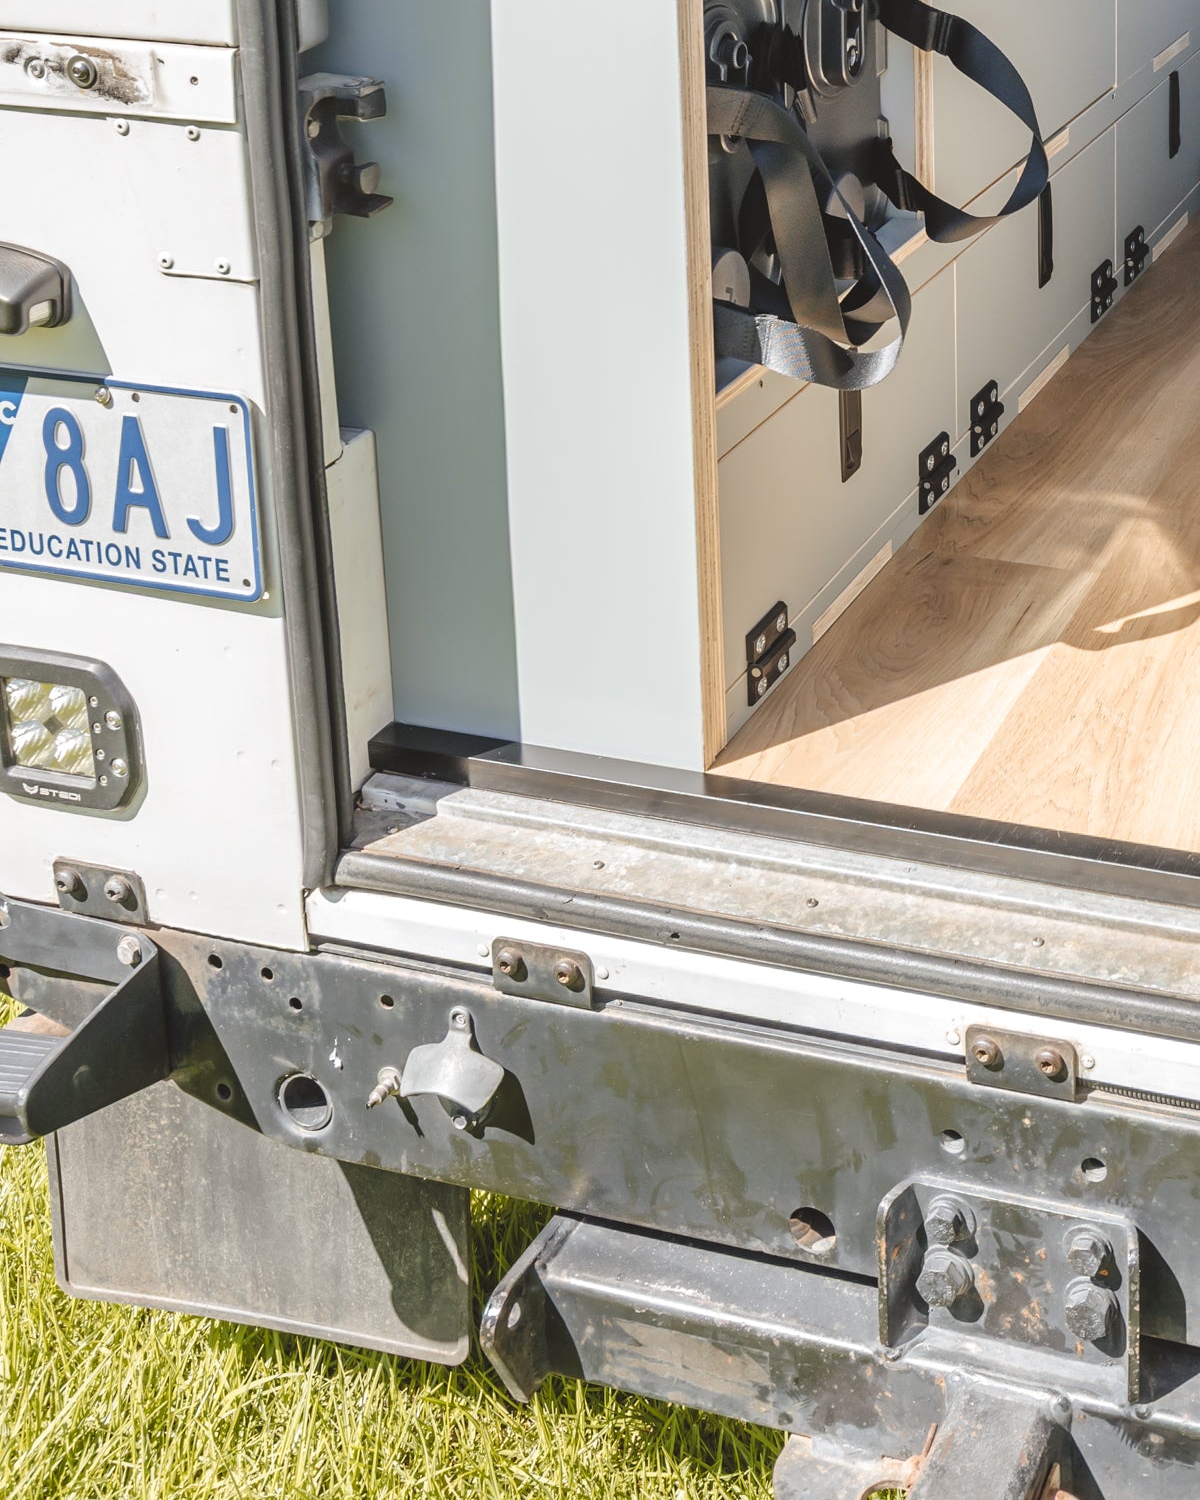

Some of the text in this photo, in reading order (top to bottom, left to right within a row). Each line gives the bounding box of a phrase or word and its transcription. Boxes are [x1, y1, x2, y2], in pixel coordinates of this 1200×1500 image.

[42, 406, 234, 545] 8AJ
[0, 528, 230, 583] EDUCATION STATE
[39, 787, 82, 802] STEDI
